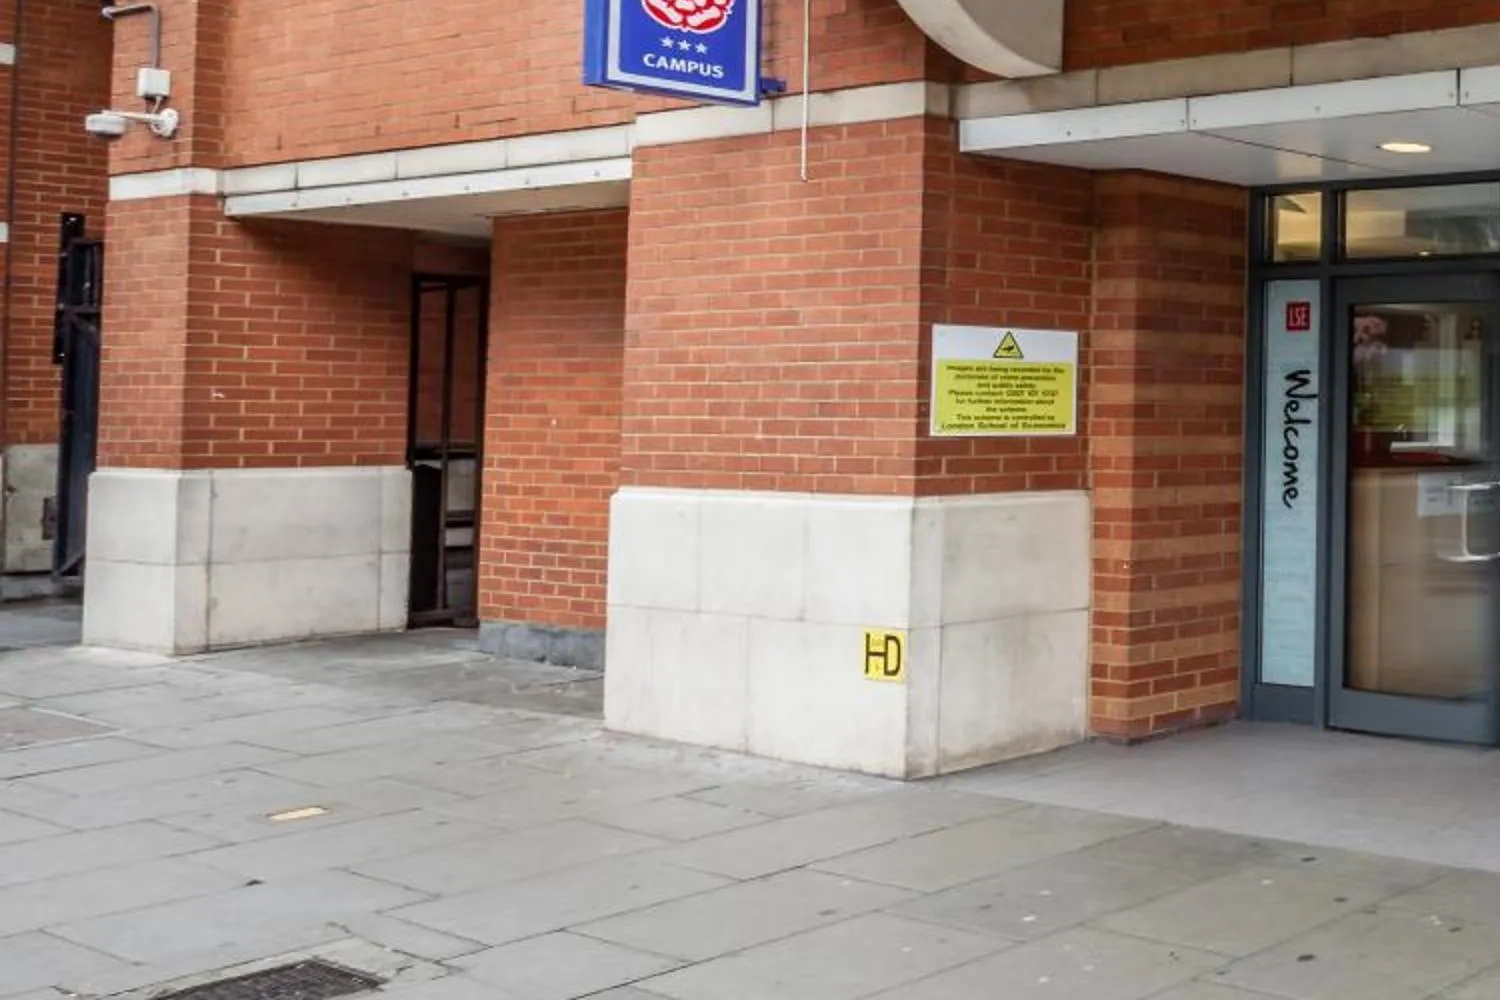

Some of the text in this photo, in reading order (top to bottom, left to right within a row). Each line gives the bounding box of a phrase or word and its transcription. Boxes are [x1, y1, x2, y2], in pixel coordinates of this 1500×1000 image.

[642, 53, 724, 79] CAMPUS
[1287, 304, 1308, 328] LSE
[1282, 369, 1319, 509] Welcome
